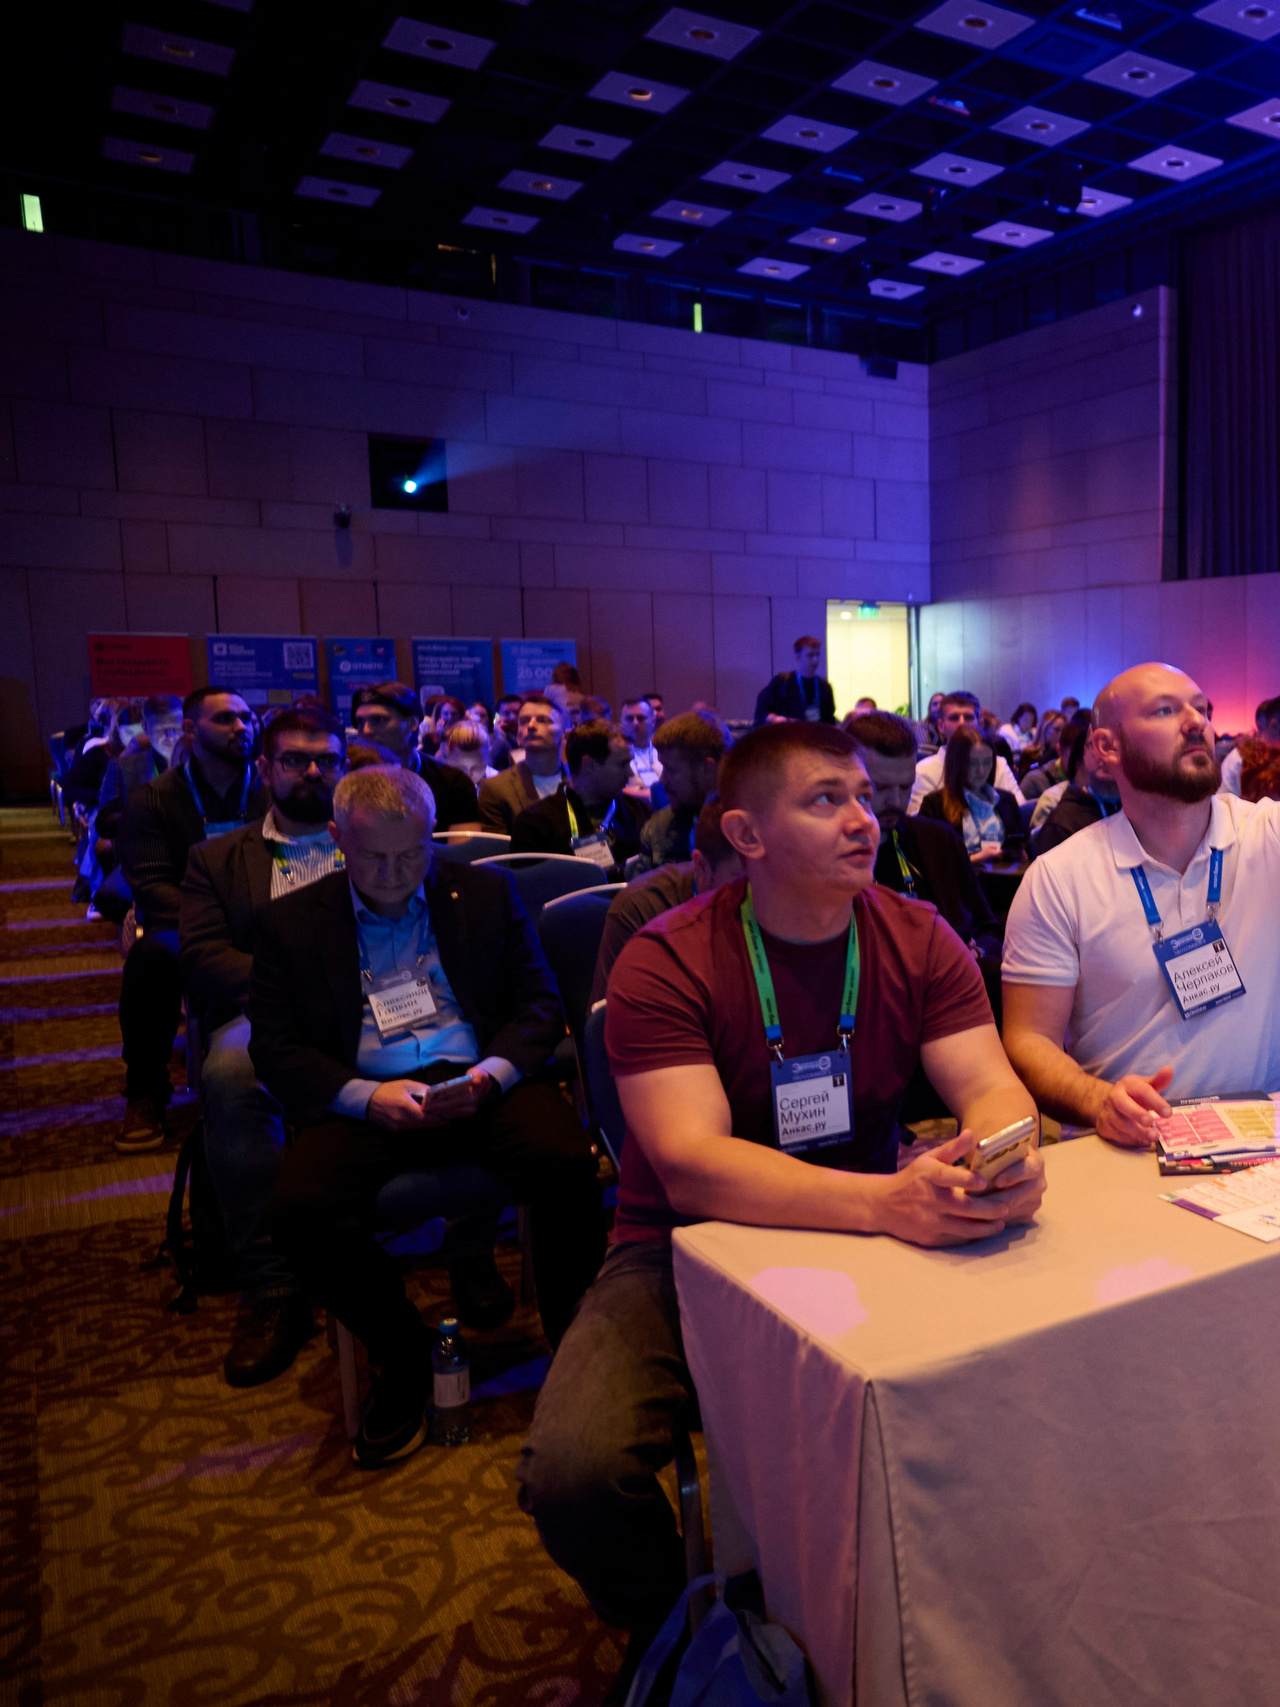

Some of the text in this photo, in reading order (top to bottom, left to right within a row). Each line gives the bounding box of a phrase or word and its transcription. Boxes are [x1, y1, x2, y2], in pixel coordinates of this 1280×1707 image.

[1174, 953, 1223, 983] Алексей
[1176, 963, 1235, 992] Черпаков
[1183, 982, 1221, 1004] Анкас.ру
[780, 1090, 830, 1111] Сергей
[780, 1106, 826, 1126] Мухин
[781, 1121, 827, 1137] Анкас.ру
